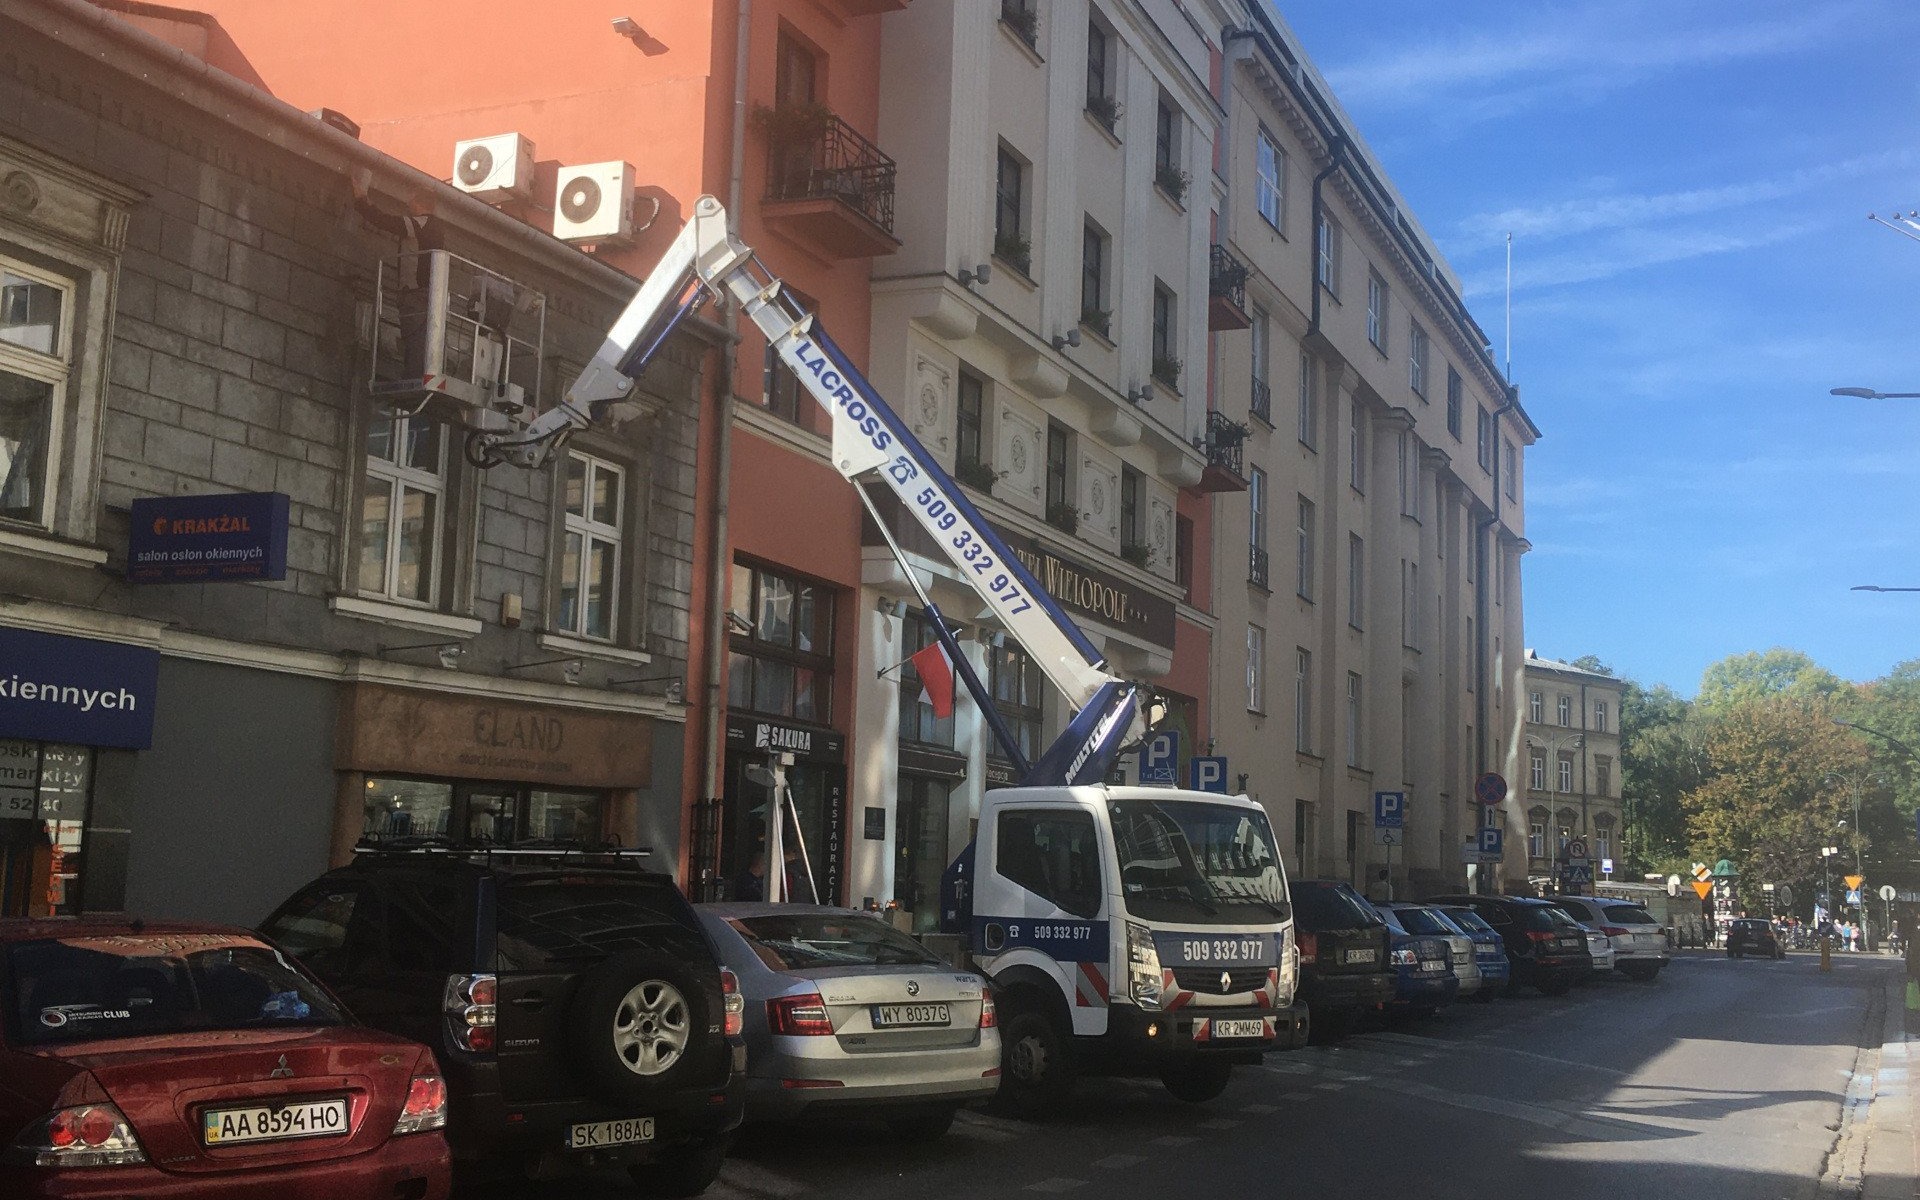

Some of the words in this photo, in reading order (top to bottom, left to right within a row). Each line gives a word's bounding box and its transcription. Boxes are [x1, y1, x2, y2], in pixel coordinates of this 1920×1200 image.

[795, 341, 891, 451] LACROSS
[137, 550, 168, 563] salon
[205, 546, 263, 561] okiennych
[917, 487, 957, 531] 509
[953, 531, 993, 576] 332
[989, 574, 1031, 615] 977
[1045, 554, 1128, 623] WIELOPOLE
[771, 726, 811, 751] SAKURA
[1149, 734, 1171, 767] P
[1198, 761, 1220, 791] P
[1381, 795, 1398, 817] P
[828, 787, 839, 907] RESTAURACJA
[1484, 831, 1497, 849] P
[1034, 926, 1051, 939] 509
[1053, 926, 1071, 939] 332
[1073, 926, 1091, 940] 977
[1183, 941, 1210, 961] 509
[1213, 941, 1238, 960] 332
[1241, 940, 1263, 960] 977
[103, 1010, 130, 1019] CLUB
[881, 1007, 901, 1023] WY
[906, 1005, 948, 1021] 8037G
[1218, 1021, 1233, 1037] KR
[1233, 1020, 1262, 1036] 2MM69
[221, 1114, 253, 1138] AA
[257, 1108, 306, 1134] 8594
[310, 1105, 340, 1129] HO
[575, 1125, 599, 1146] SK
[606, 1119, 652, 1143] 188AC
